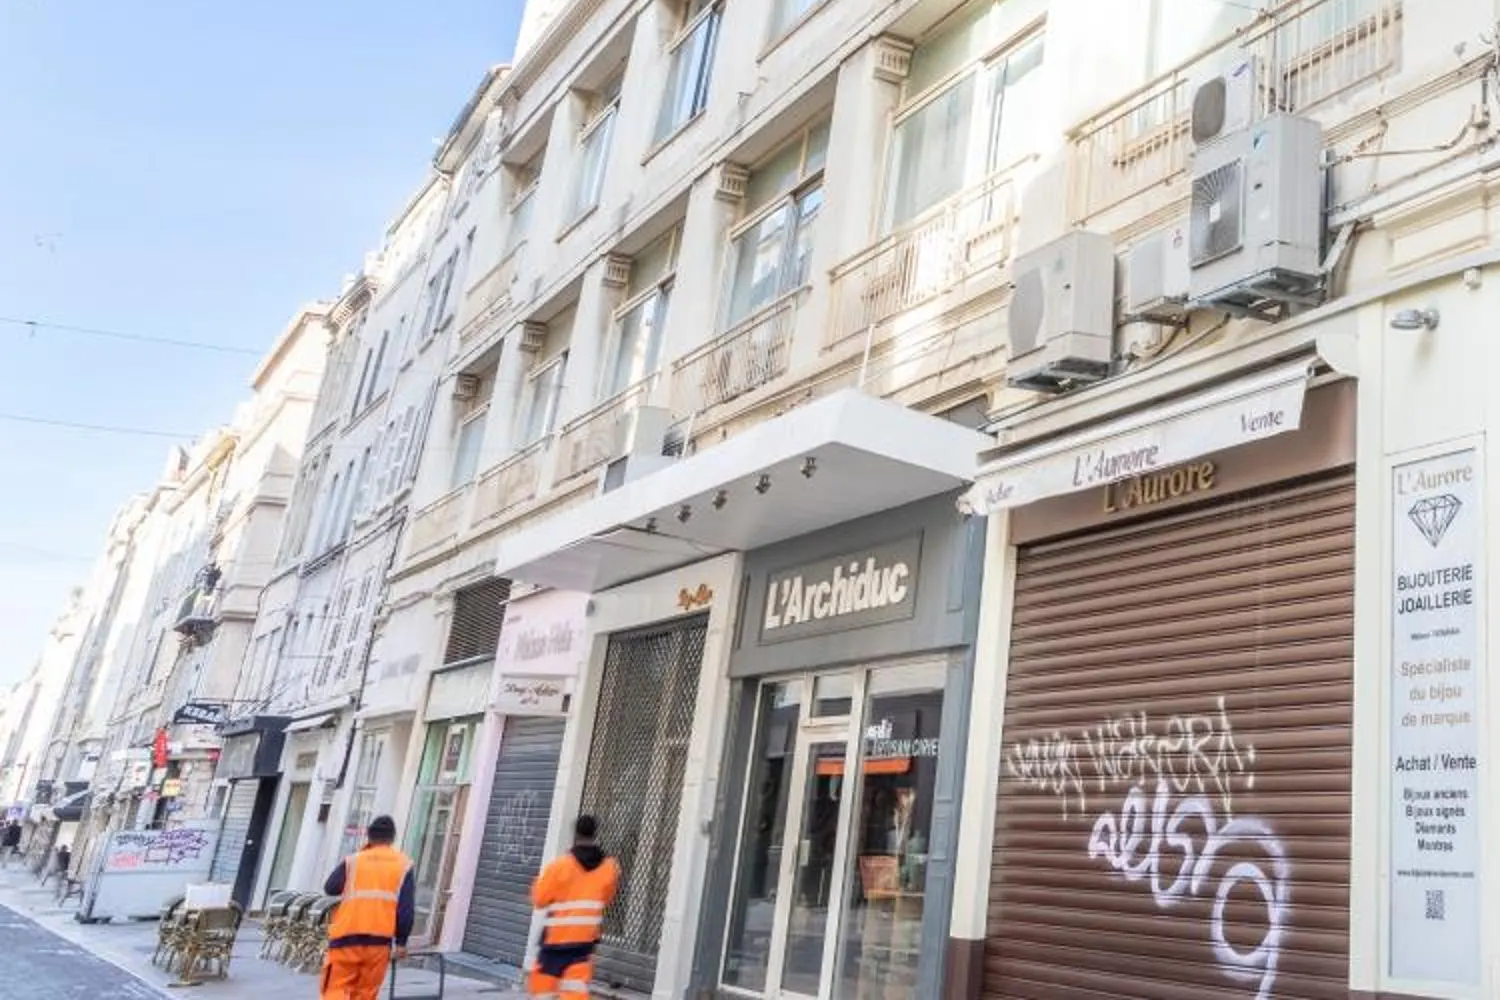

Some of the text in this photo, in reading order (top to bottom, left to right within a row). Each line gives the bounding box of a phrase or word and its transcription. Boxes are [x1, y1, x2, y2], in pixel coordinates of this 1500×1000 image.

[1240, 410, 1285, 433] Vente
[1397, 465, 1473, 495] L'Aurore
[1397, 562, 1473, 591] BIJOUTERIE
[764, 556, 909, 631] L'Archiduc
[1397, 587, 1473, 615] JOAILLERIE
[1400, 657, 1472, 680] Spécialiste
[1409, 682, 1462, 703] du bijou
[1401, 711, 1472, 729] de marque
[1396, 755, 1431, 772] Achat
[1441, 753, 1477, 770] Vente
[1405, 804, 1433, 819] Bijoux
[1414, 821, 1457, 834] Diamants
[1416, 838, 1454, 851] Montres
